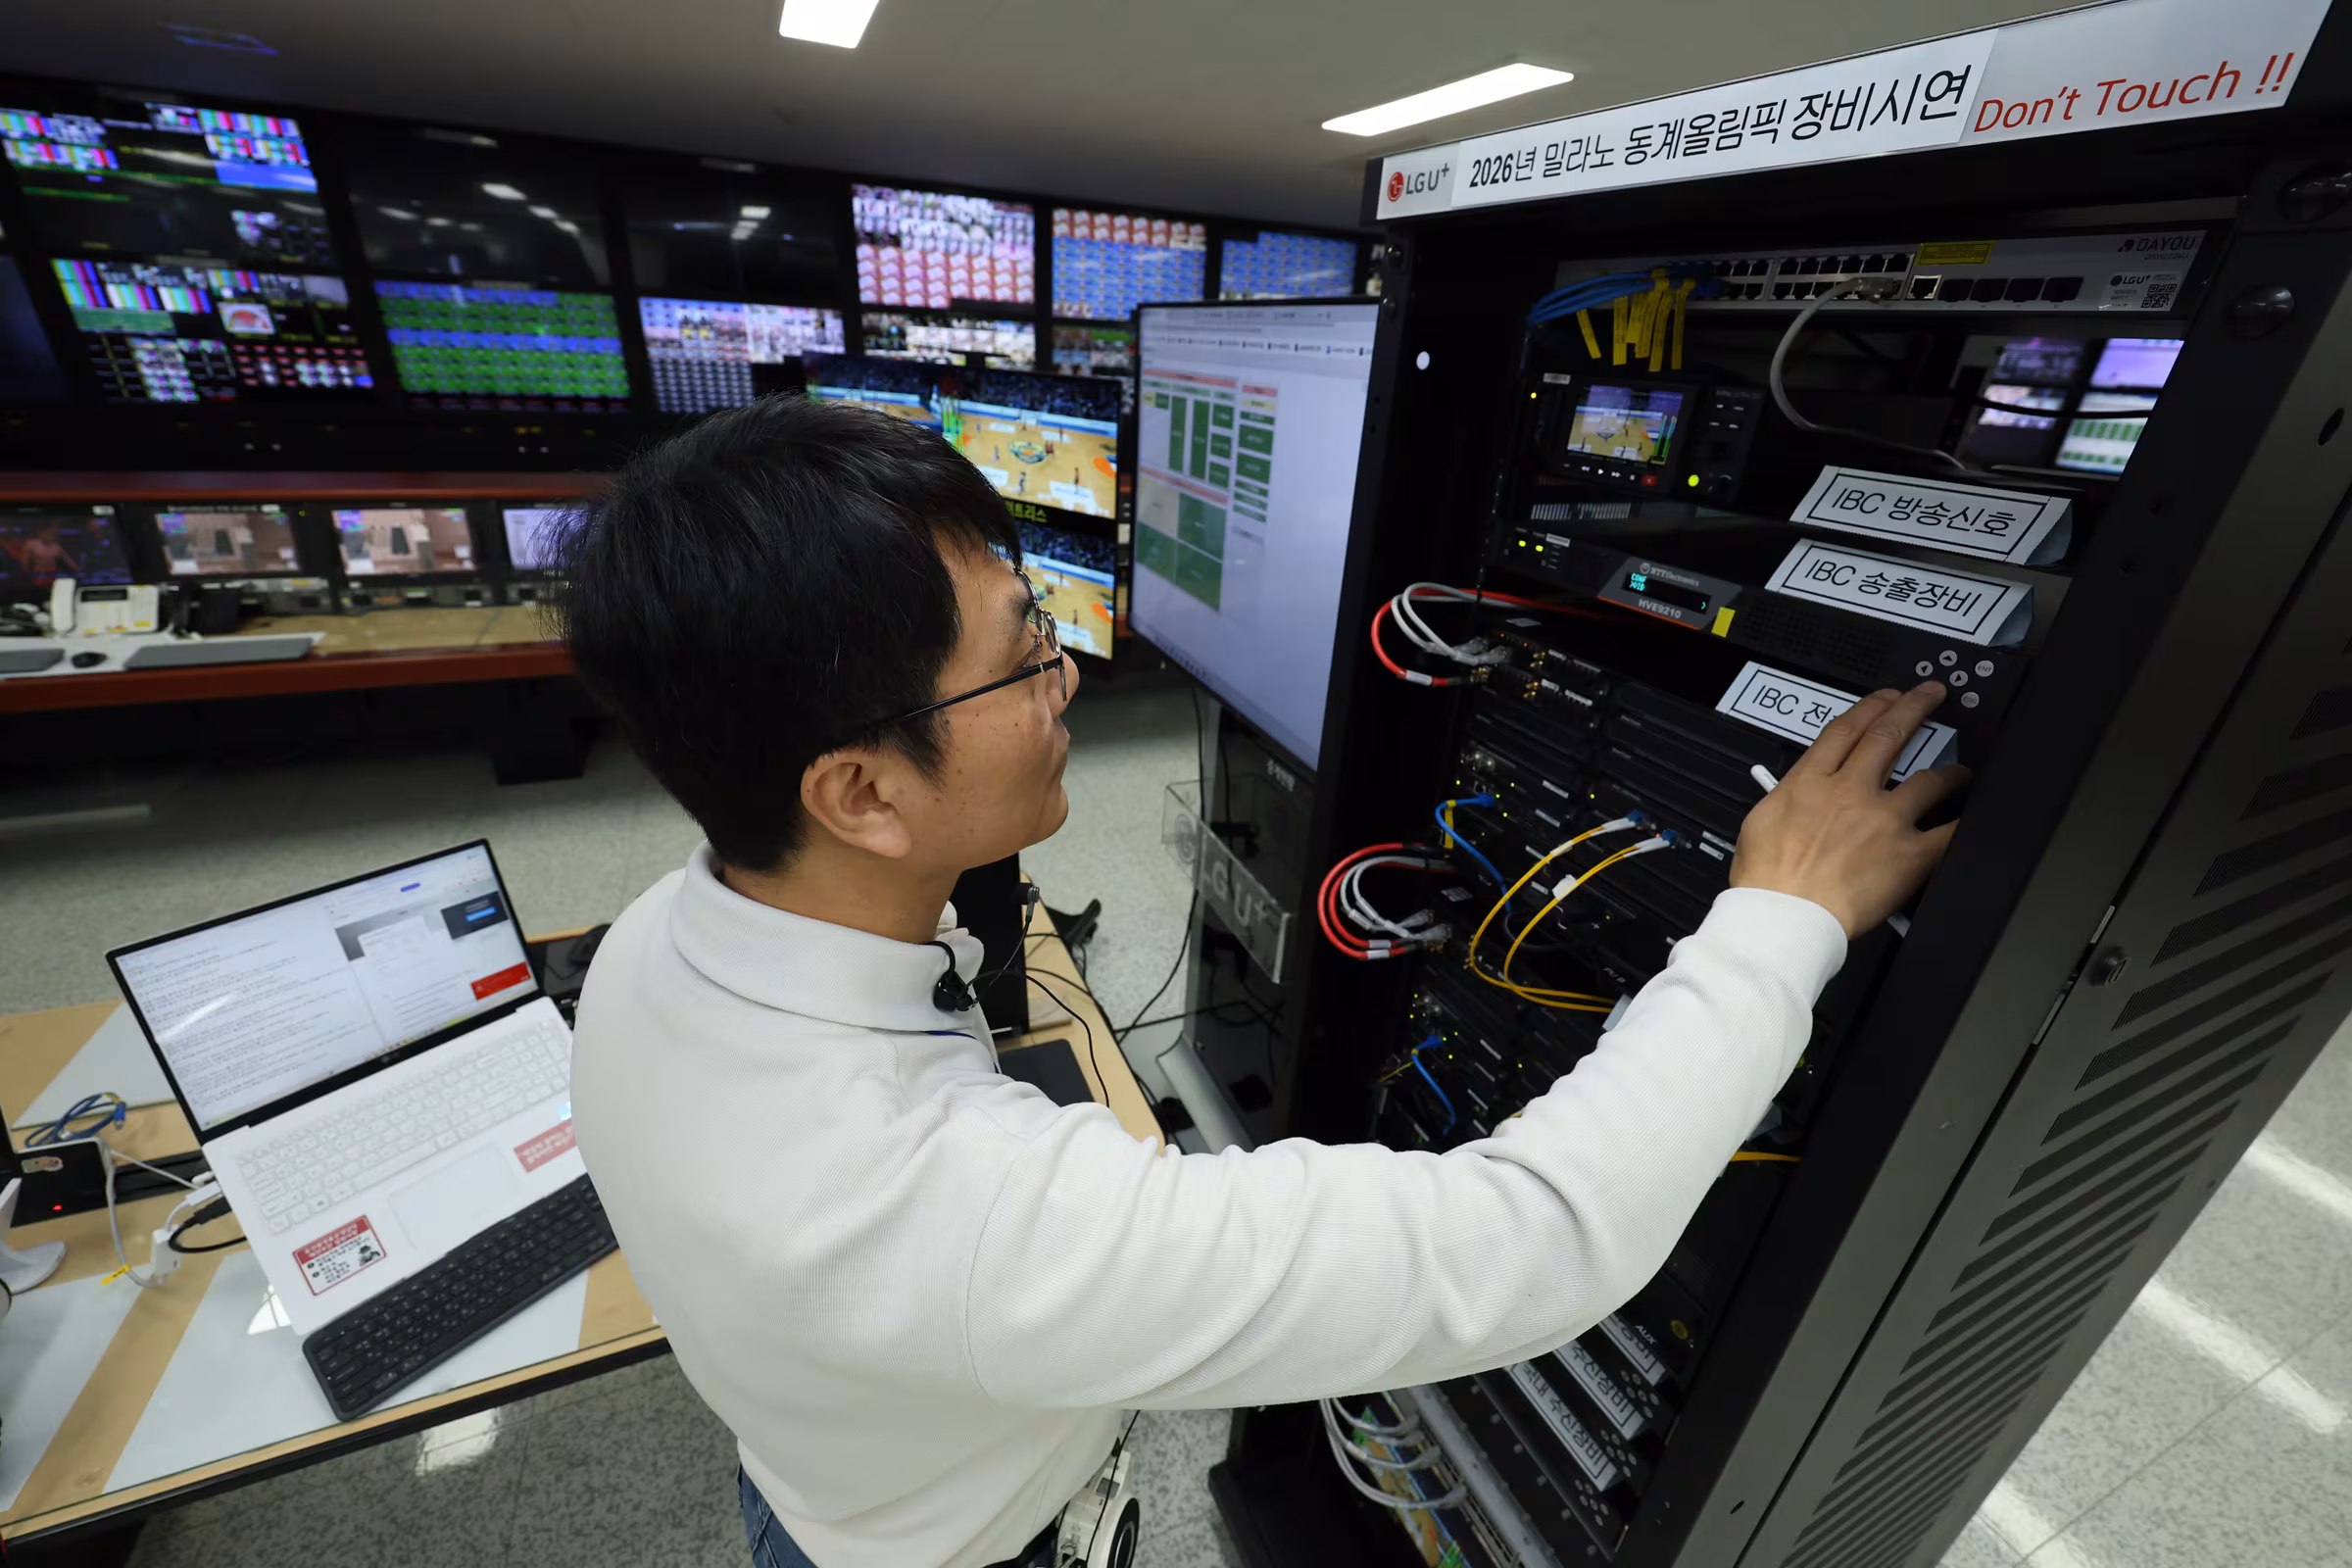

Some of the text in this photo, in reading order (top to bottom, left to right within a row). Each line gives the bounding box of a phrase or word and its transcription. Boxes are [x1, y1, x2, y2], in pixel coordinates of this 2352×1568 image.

[1974, 86, 2082, 133] Don't
[2096, 61, 2241, 114] Touch
[1469, 64, 1973, 188] 2026년 밀라노 동계올림픽 장비시연
[2136, 236, 2196, 252] DAYOU
[1832, 487, 2017, 537] IBC 방송신호
[1805, 559, 1983, 617] IBC 송출장비
[1639, 600, 1681, 618] HVE9210
[1752, 685, 1799, 715] IBC
[1635, 1324, 1657, 1345] AUX
